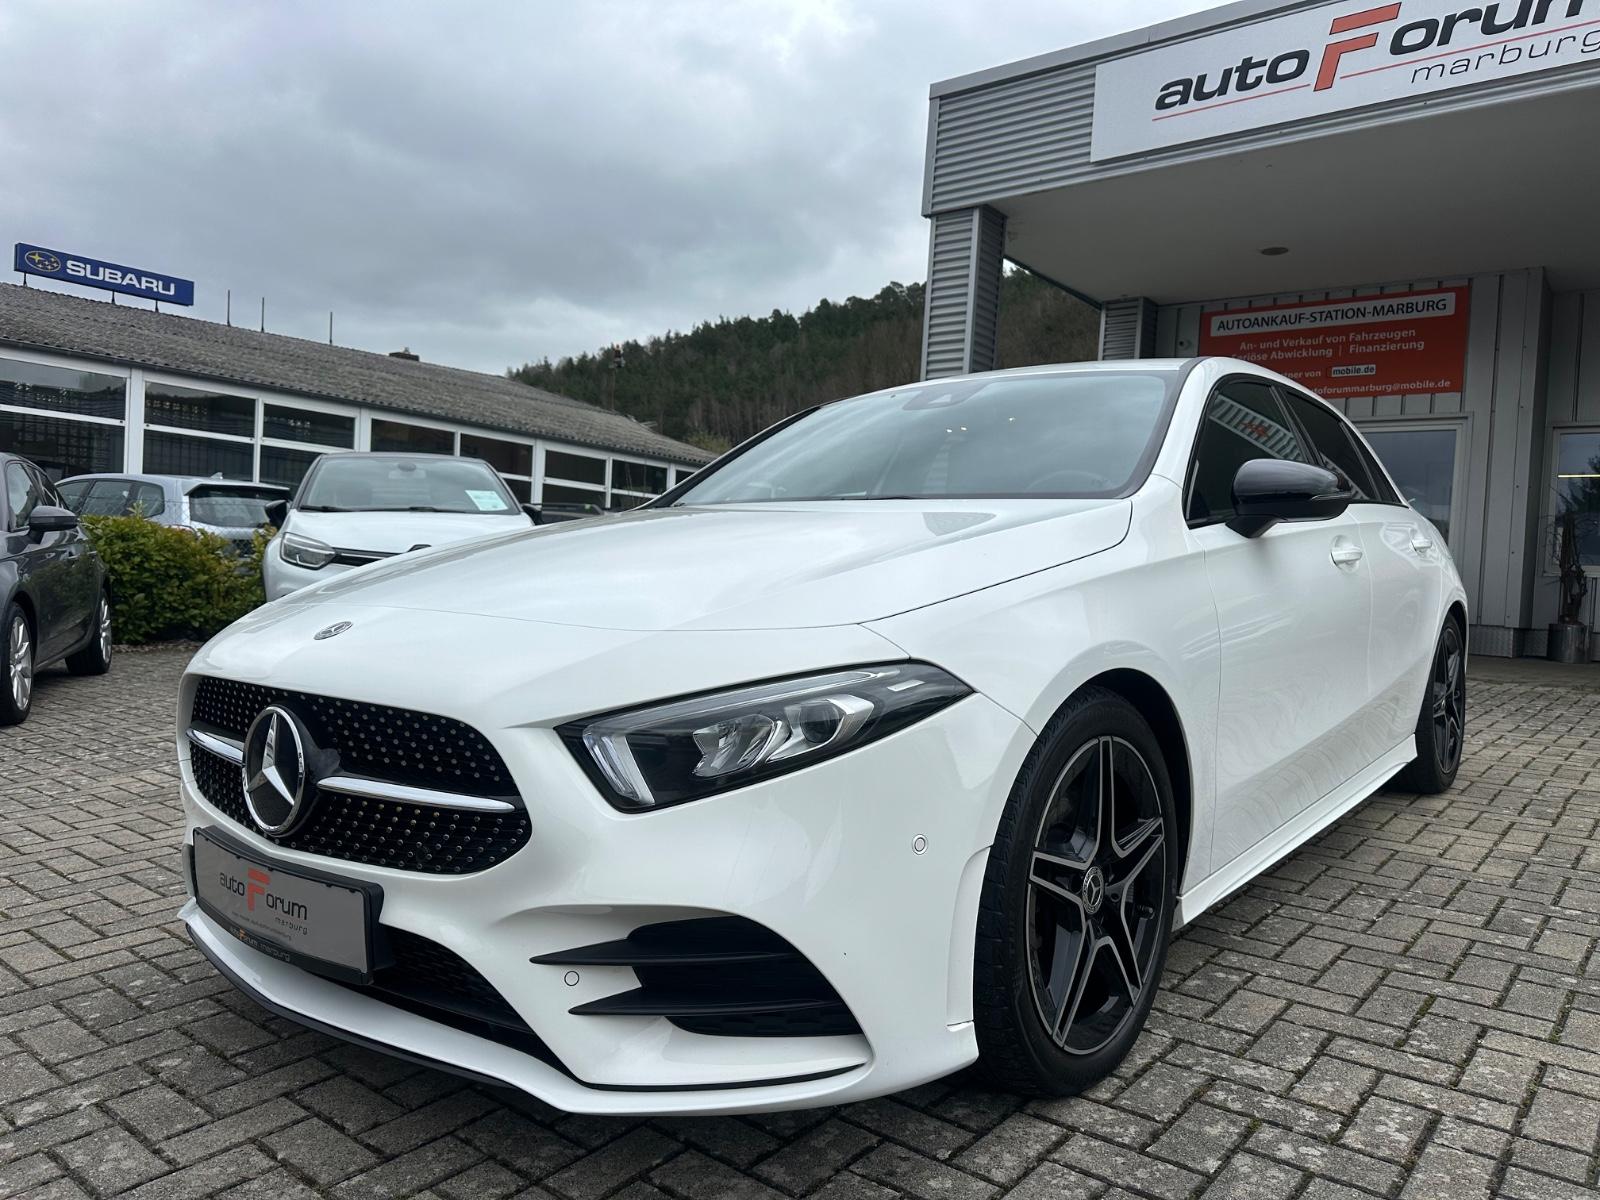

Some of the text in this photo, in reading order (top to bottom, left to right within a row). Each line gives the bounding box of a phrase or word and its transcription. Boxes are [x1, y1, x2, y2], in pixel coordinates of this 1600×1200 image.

[66, 260, 175, 296] SUBARU
[1217, 298, 1447, 331] AUTOANKAUF-STATION-MARBURG
[1240, 329, 1416, 350] An- und Verkauf von Fahrzeugen
[1270, 347, 1333, 359] Abwicklung
[1349, 341, 1425, 353] Finanzierung
[1304, 370, 1321, 378] von
[1332, 365, 1375, 375] mobile.de
[1312, 379, 1451, 394] toforummarburg@mobile.de
[275, 917, 308, 936] marburg
